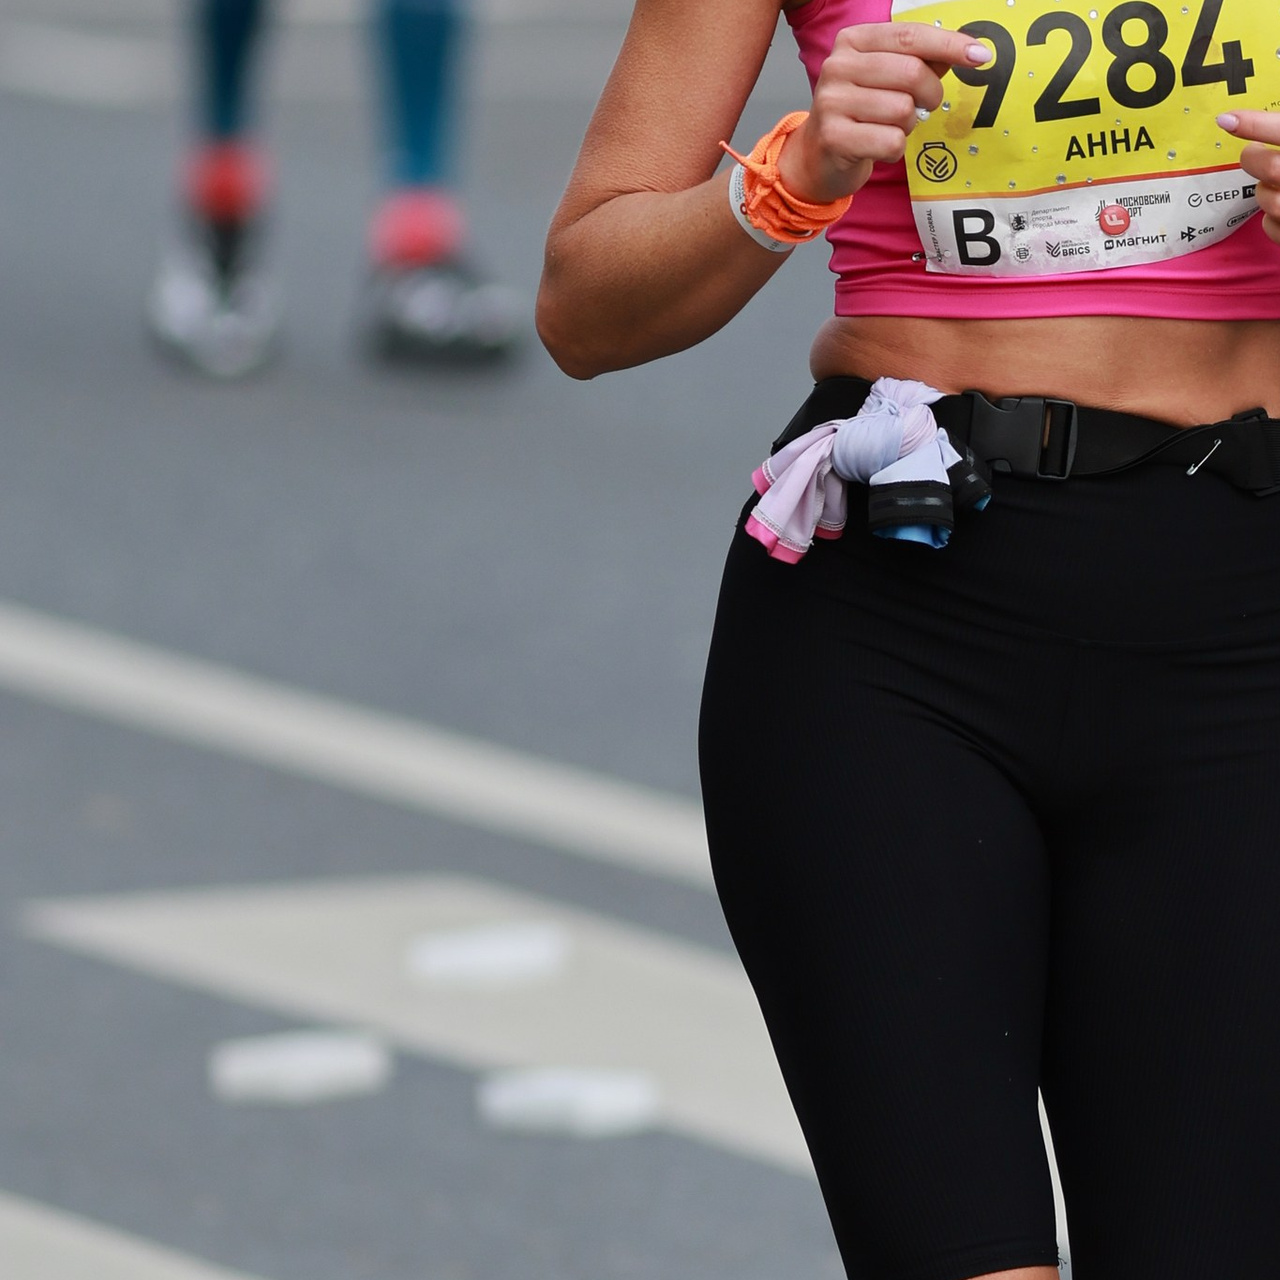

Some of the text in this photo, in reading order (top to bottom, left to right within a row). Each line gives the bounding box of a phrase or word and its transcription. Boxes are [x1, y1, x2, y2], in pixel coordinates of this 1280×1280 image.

[1065, 126, 1155, 161] АННА
[1115, 191, 1171, 207] МОСКОВСКИЙ
[1206, 190, 1239, 203] СБЕР
[926, 209, 936, 233] CORRAL
[952, 209, 1001, 266] B
[1062, 246, 1091, 257] BRICS
